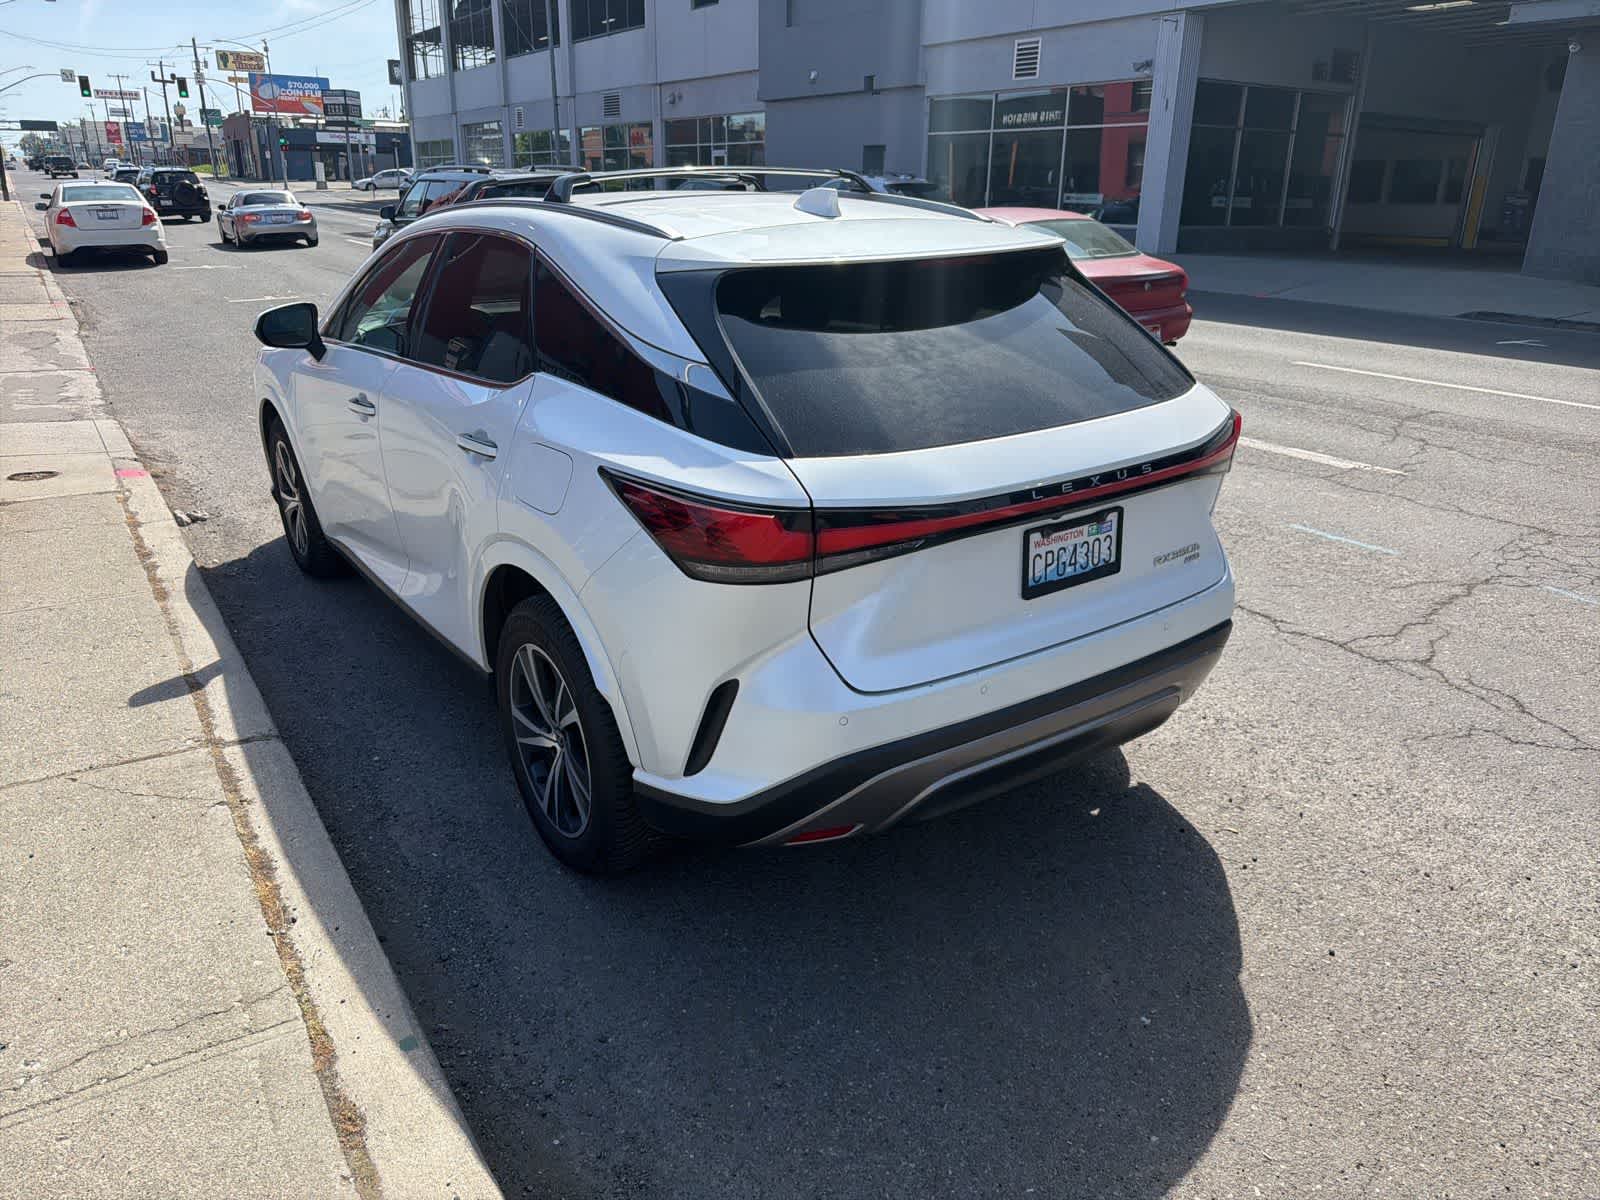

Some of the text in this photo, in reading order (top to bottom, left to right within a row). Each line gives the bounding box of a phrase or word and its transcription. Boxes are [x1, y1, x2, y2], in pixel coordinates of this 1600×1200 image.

[95, 89, 140, 97] Firesone
[280, 88, 303, 97] COIN
[287, 81, 320, 90] $70,000
[1032, 463, 1152, 499] LEXUS
[1033, 528, 1084, 549] WASHINGTON
[1032, 534, 1113, 584] CPG4303
